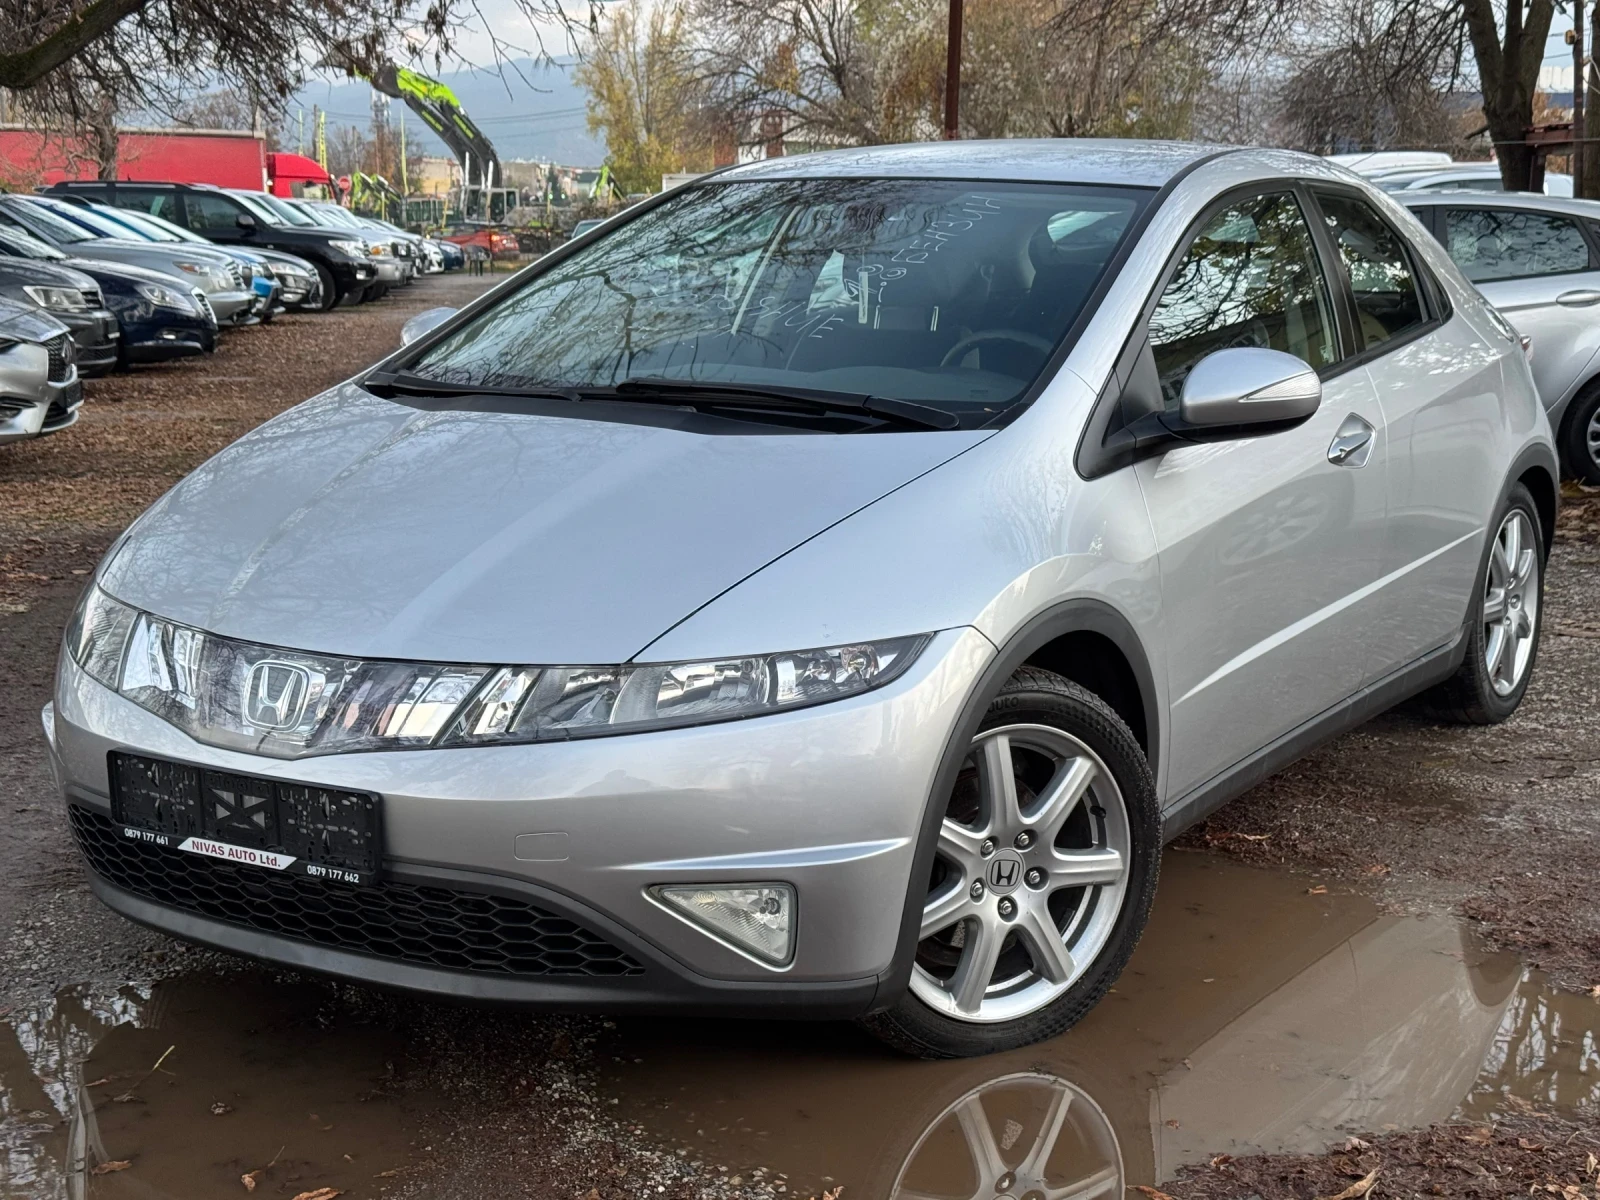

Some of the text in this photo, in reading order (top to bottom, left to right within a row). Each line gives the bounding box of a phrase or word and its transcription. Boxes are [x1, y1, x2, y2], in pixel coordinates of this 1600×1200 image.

[124, 827, 169, 846] 0879 177 661
[191, 840, 281, 868] NIVAS AUTO Ltd.
[307, 864, 360, 883] 0879 177 662
